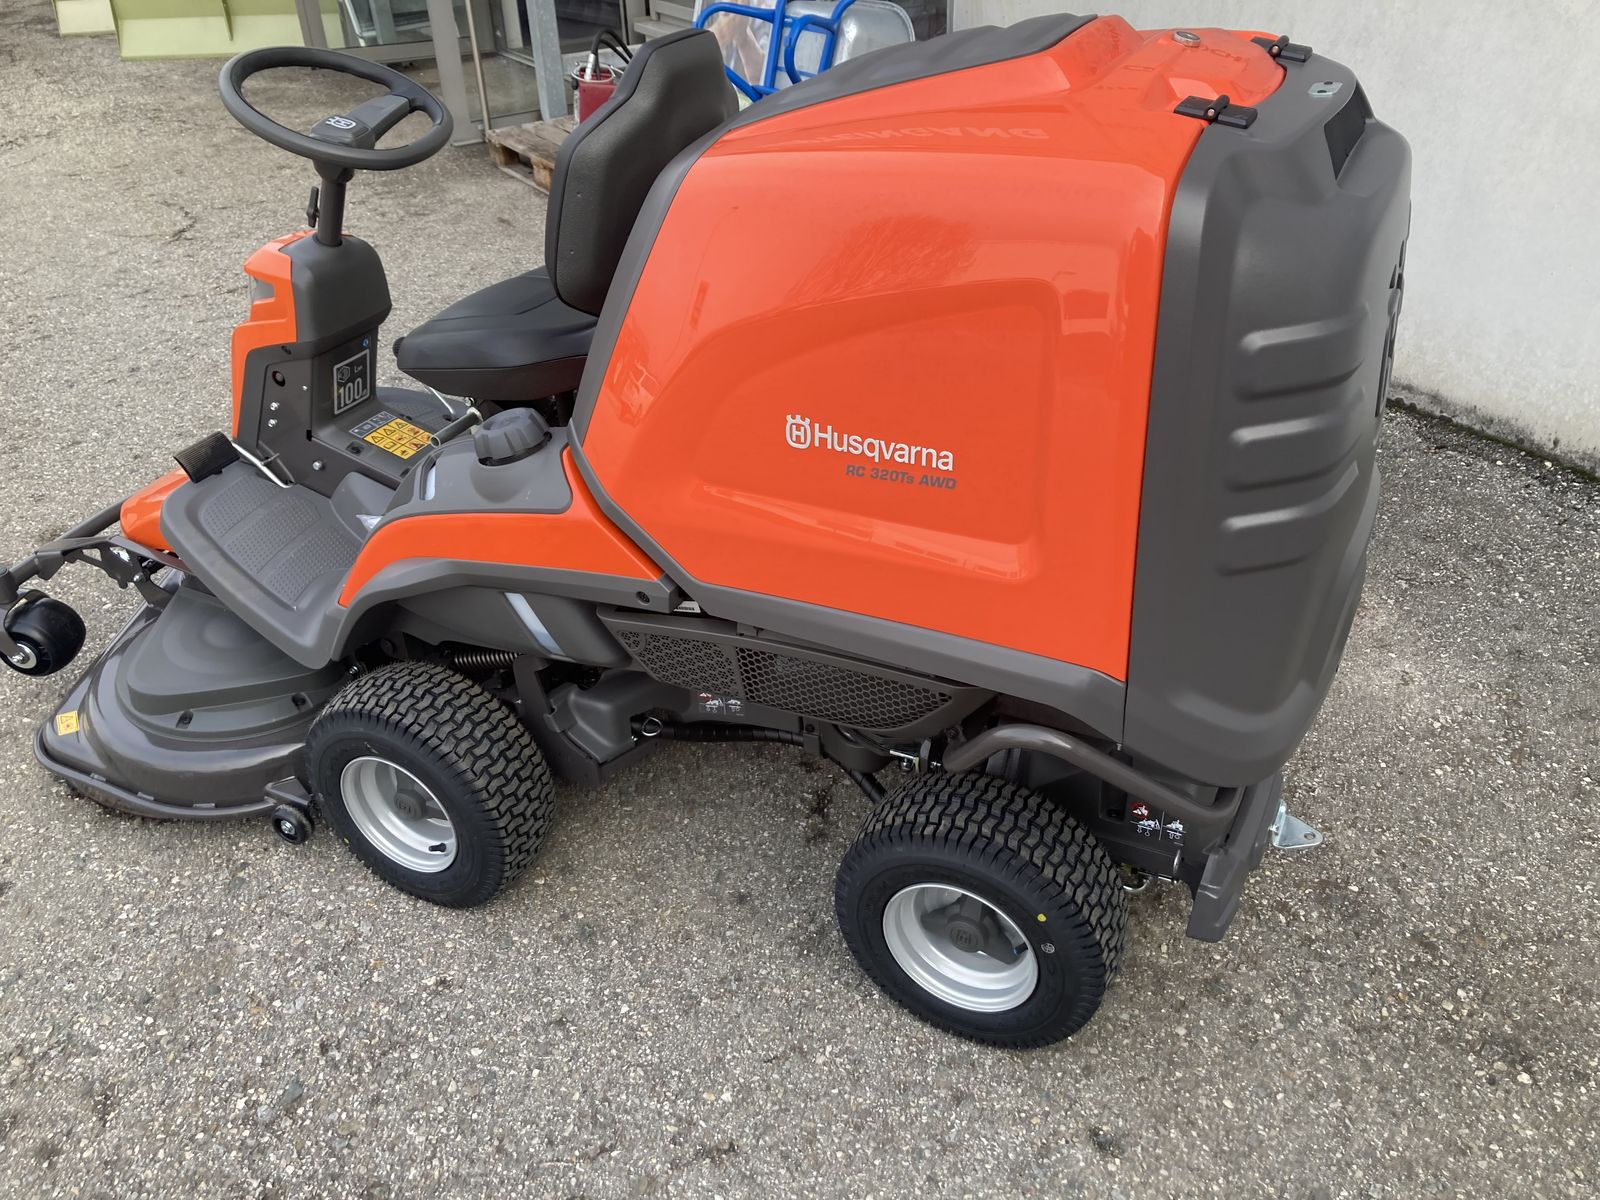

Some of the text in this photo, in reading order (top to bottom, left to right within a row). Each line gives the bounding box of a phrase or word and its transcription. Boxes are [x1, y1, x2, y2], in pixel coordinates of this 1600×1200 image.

[338, 377, 362, 408] 100
[814, 422, 954, 471] Husqvarna
[846, 464, 956, 490] RC 320Ts AWD
